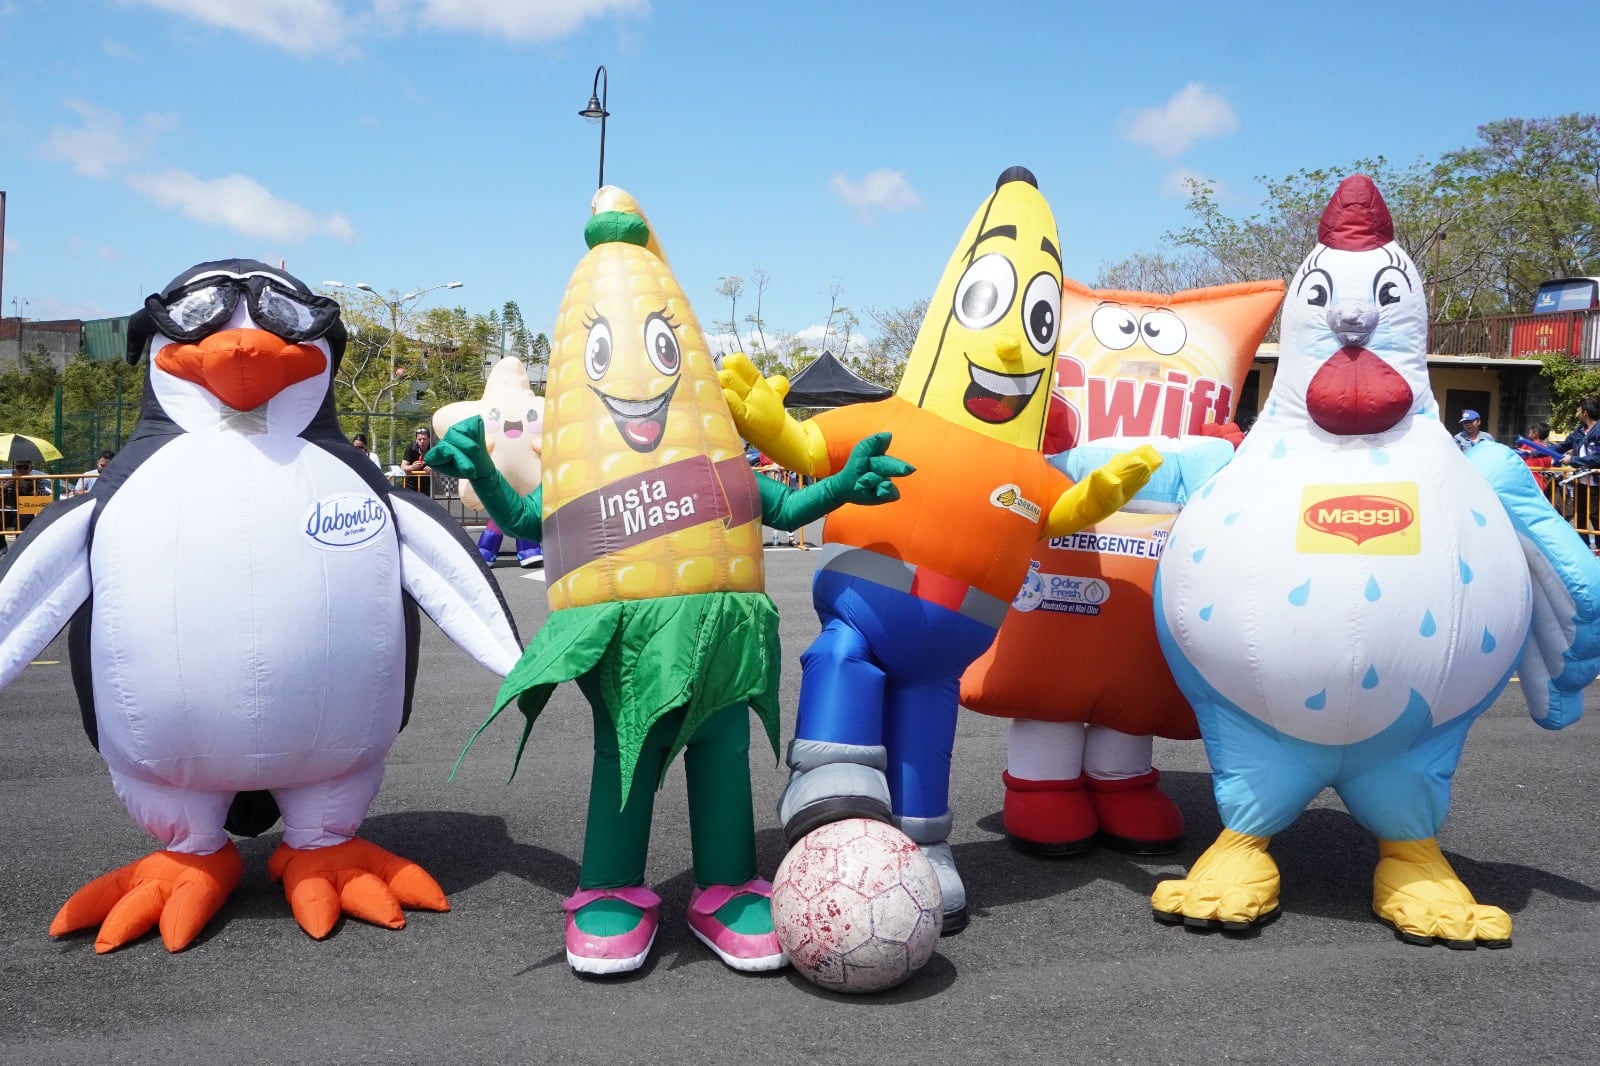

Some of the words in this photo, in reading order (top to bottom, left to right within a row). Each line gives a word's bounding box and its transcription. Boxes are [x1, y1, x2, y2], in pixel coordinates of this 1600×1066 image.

[1043, 354, 1232, 455] Swift
[600, 480, 667, 520] Insta
[306, 497, 383, 536] Jabonito
[622, 495, 696, 536] Masa
[1318, 507, 1401, 525] Maggi
[1051, 533, 1146, 556] DETERGENTE
[1148, 539, 1164, 558] LÍ
[1051, 577, 1082, 589] Odor
[1051, 587, 1080, 598] Fresh
[1041, 600, 1068, 611] Neutraliza
[1069, 604, 1075, 612] el
[1075, 604, 1086, 613] Mal
[1087, 605, 1100, 615] Olor
